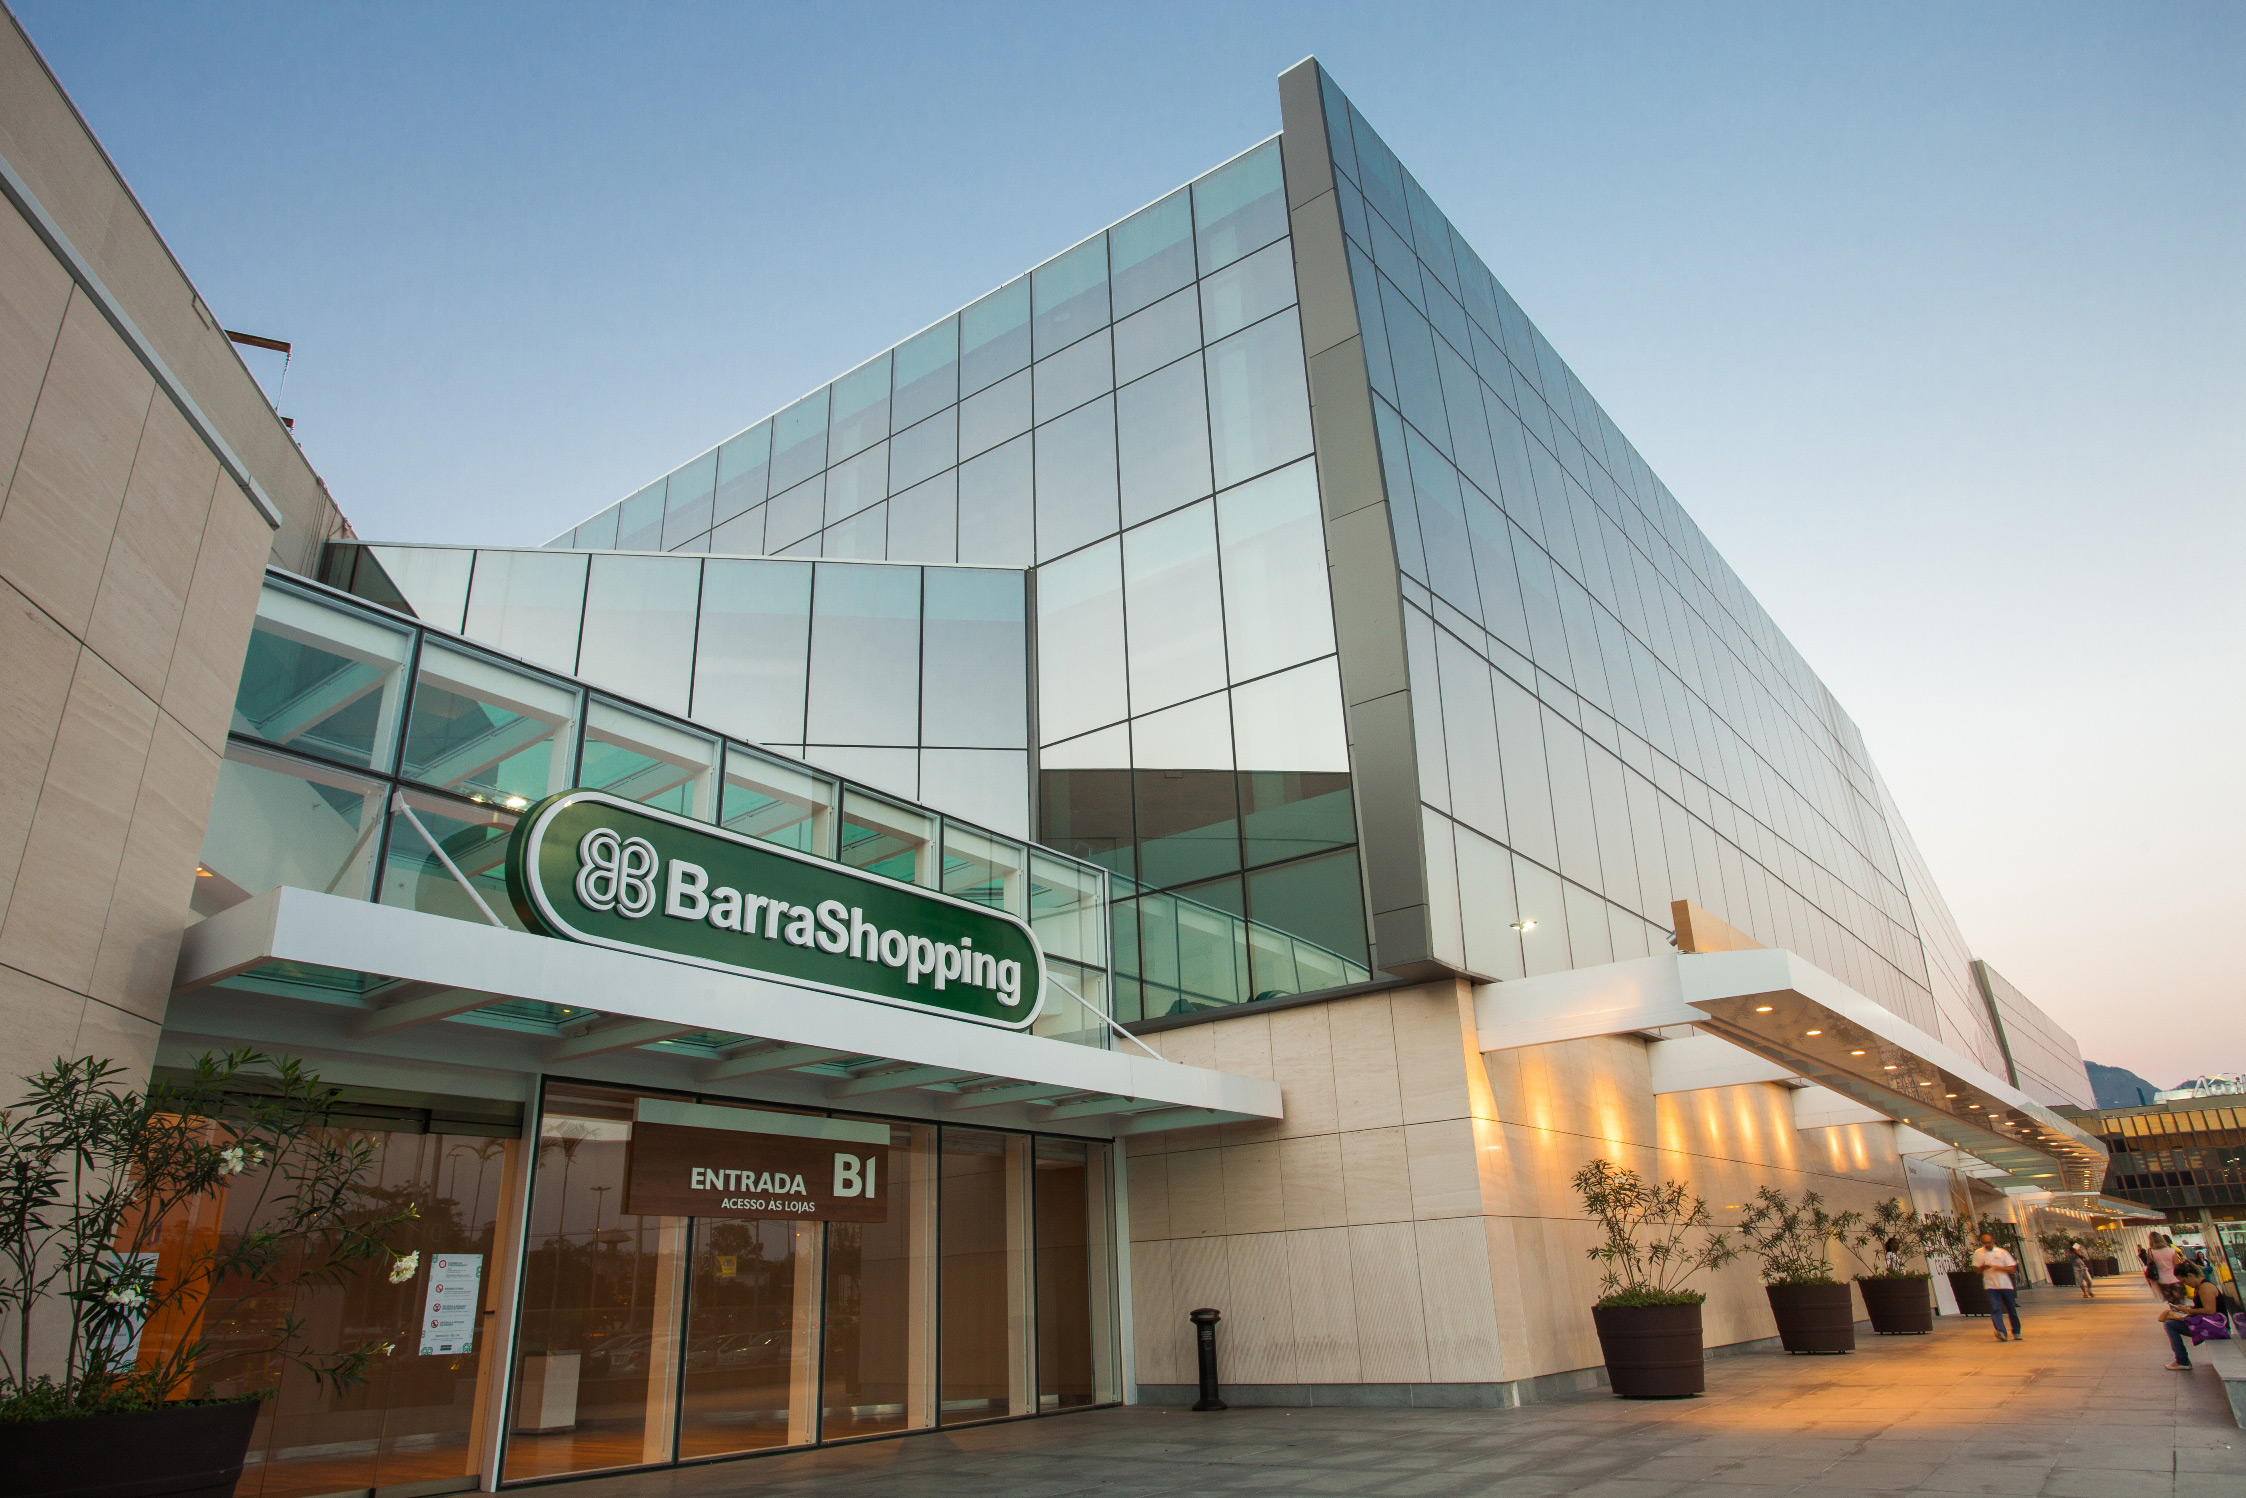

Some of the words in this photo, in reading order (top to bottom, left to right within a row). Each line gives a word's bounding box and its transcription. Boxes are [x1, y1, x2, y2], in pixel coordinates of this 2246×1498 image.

[665, 859, 1022, 1005] BarraShopping
[690, 1167, 807, 1195] ENTRADA
[720, 1197, 766, 1211] ACESSO
[768, 1197, 783, 1211] ÀS
[784, 1201, 815, 1214] LOJAS
